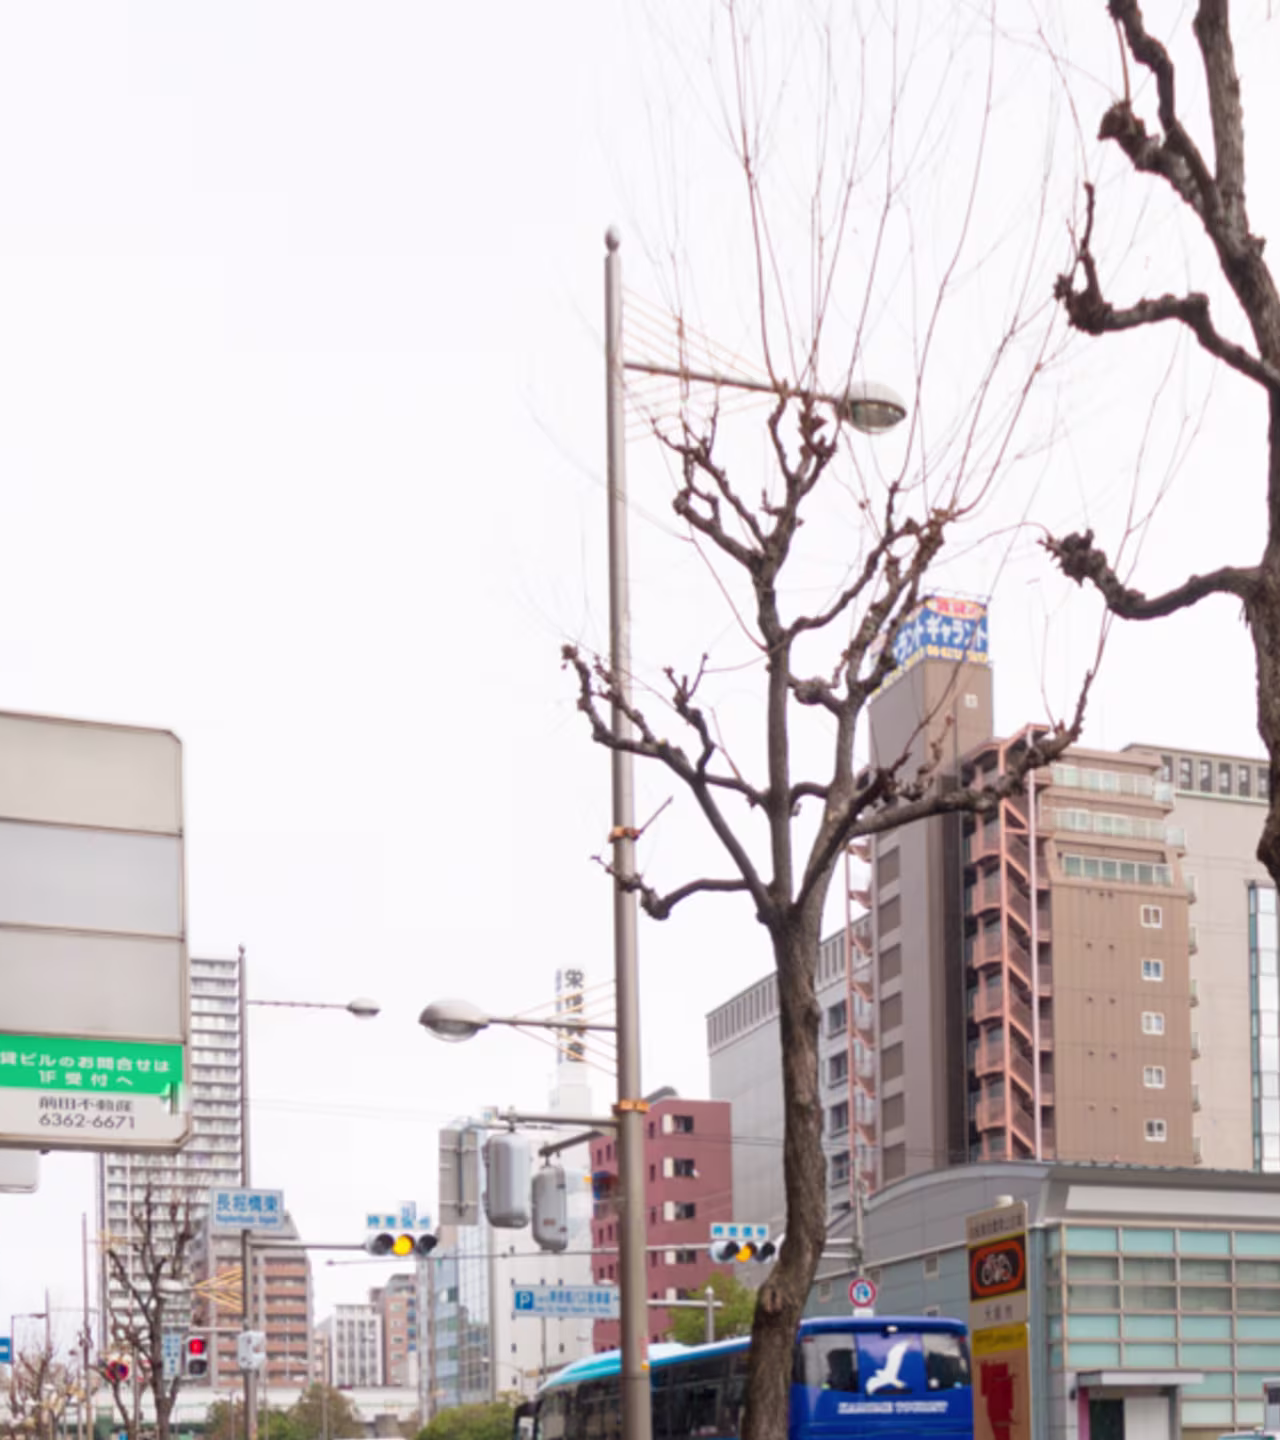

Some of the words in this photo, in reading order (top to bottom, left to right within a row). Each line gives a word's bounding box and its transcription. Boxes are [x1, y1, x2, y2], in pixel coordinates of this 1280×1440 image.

[0, 1050, 171, 1073] 貸ビルのお問合せは
[38, 1112, 136, 1130] 6362-6671
